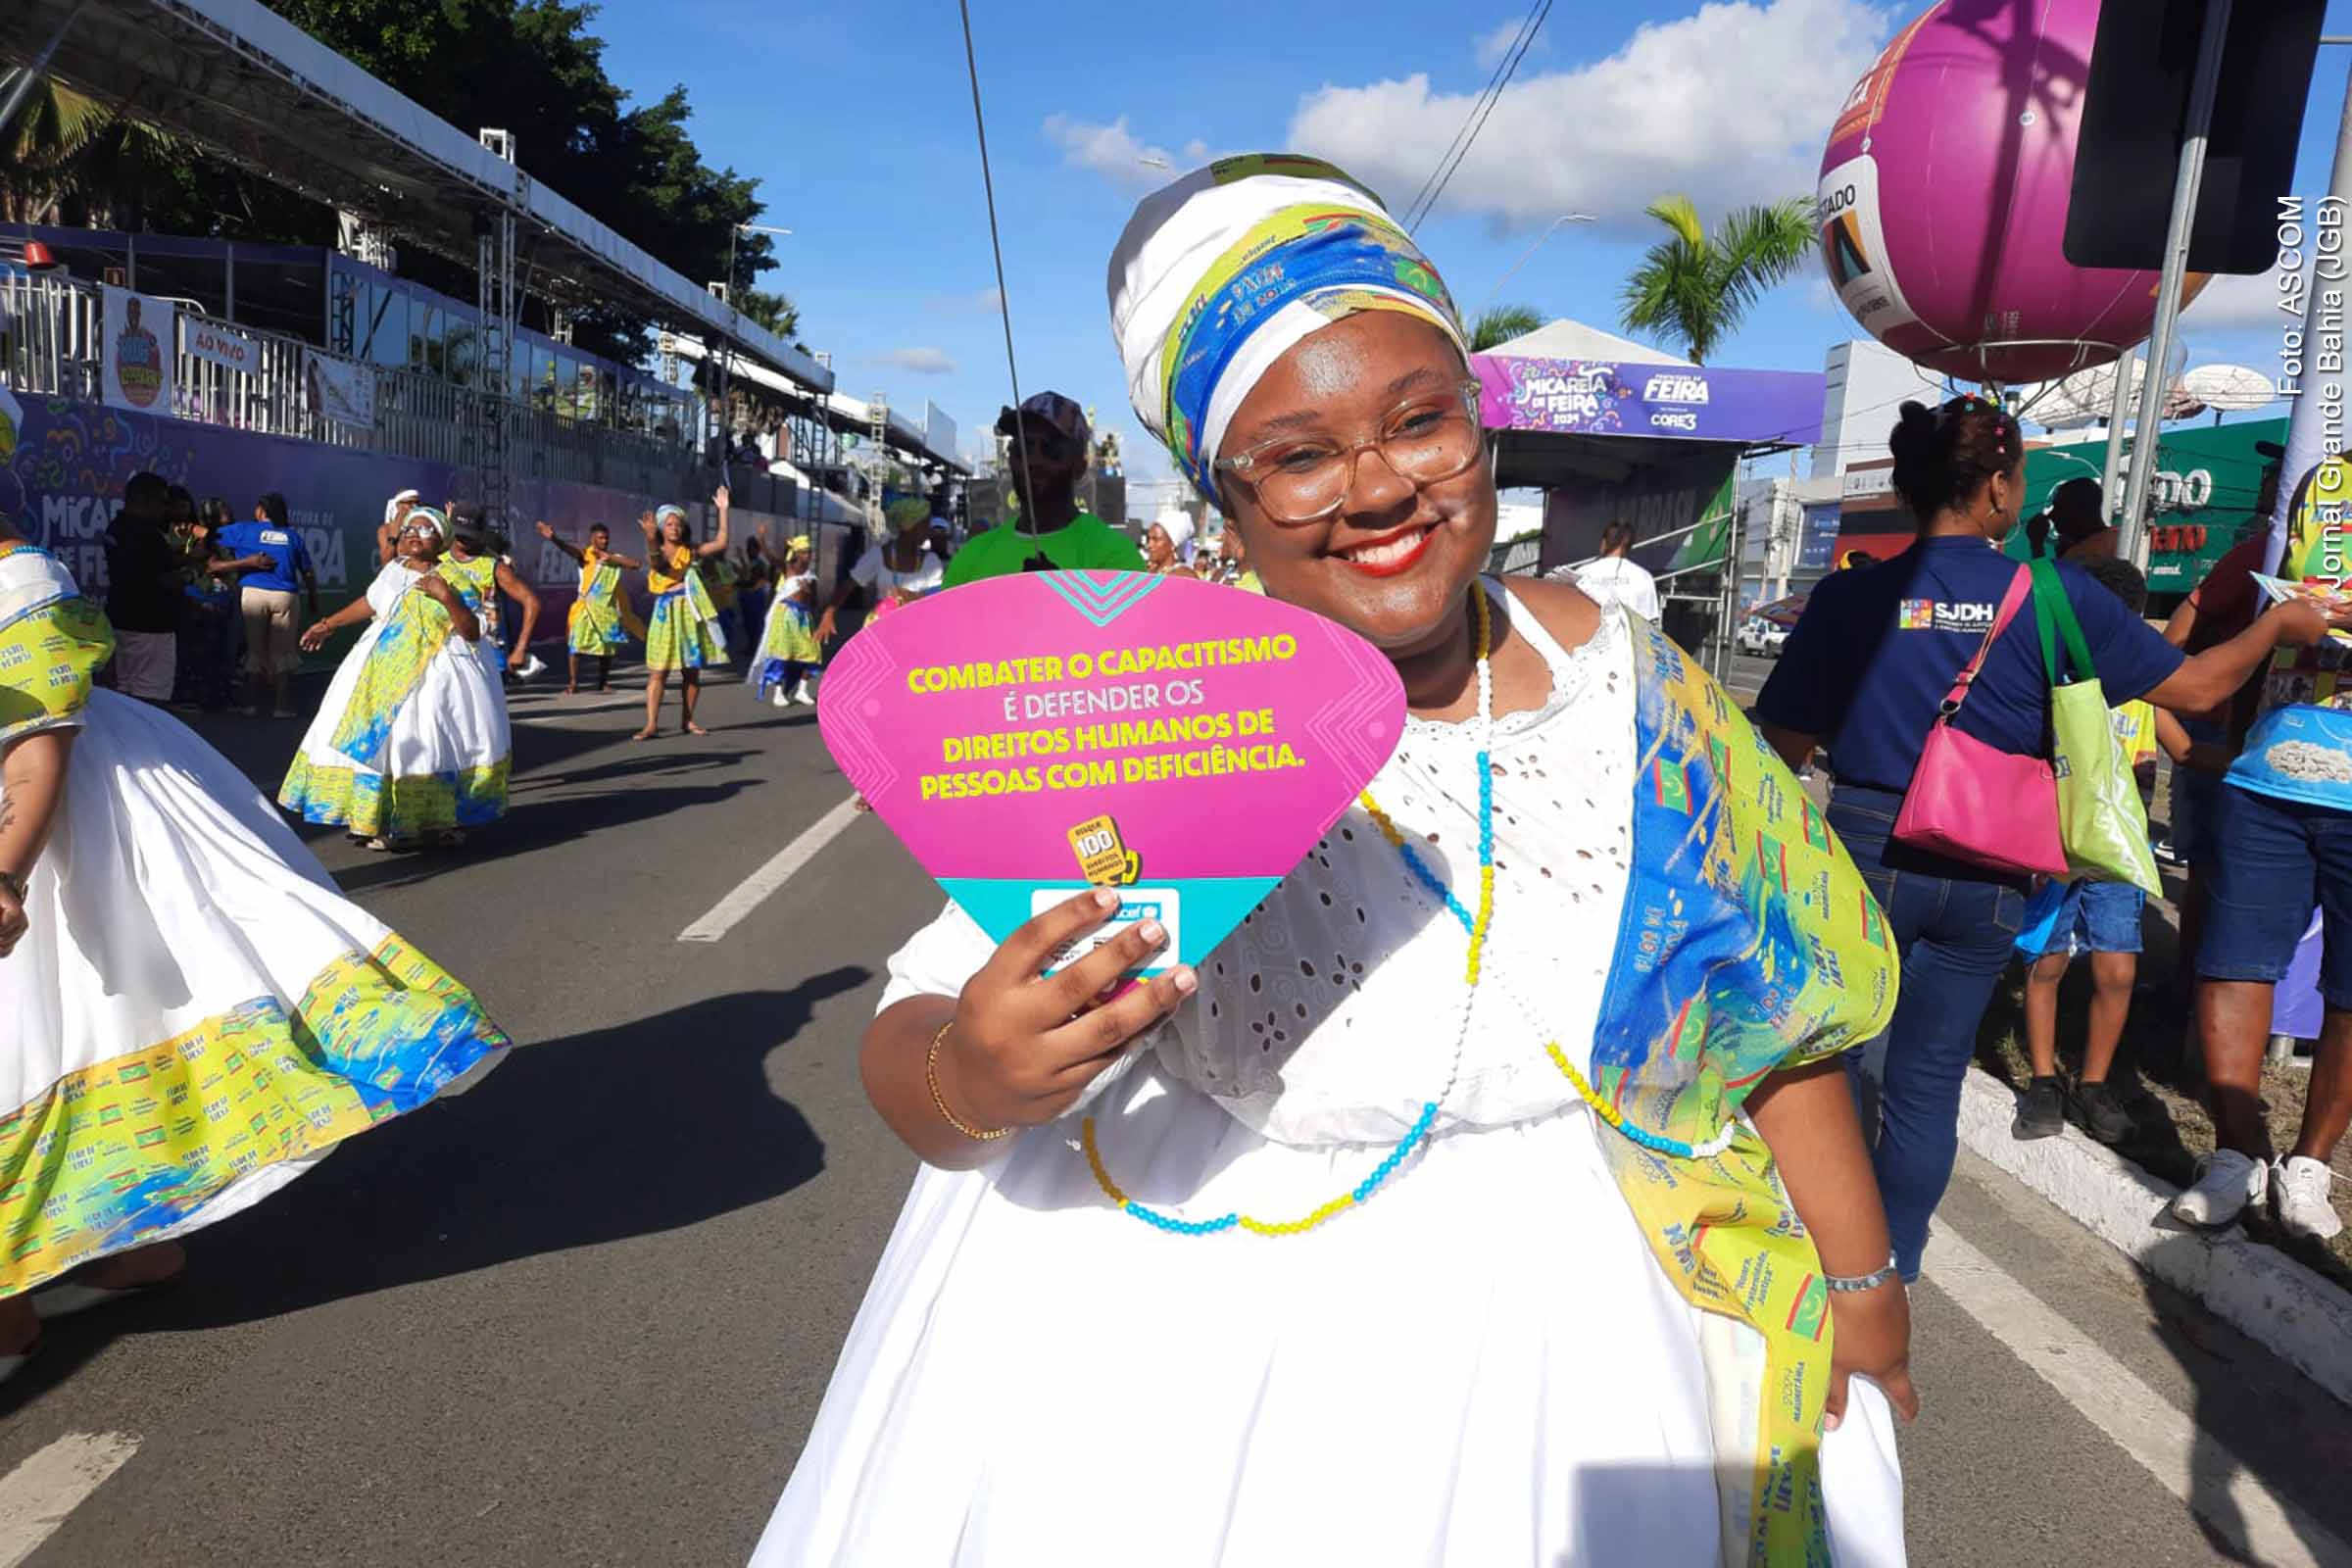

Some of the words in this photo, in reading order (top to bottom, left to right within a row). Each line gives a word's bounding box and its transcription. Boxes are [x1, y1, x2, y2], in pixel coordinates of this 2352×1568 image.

[196, 330, 214, 351] AO
[217, 338, 244, 362] VIVO
[1547, 393, 1599, 416] FEIRA
[1643, 379, 1709, 401] FEIRA
[1650, 414, 1697, 430] CORE3
[1935, 602, 1994, 621] SJDH
[907, 655, 1063, 695] COMBATER
[1067, 653, 1095, 680] O
[1097, 633, 1298, 677] CAPACITISMO
[1003, 690, 1019, 722] É
[1024, 684, 1160, 720] DEFENDER
[1164, 678, 1205, 707] OS
[942, 726, 1072, 763] DIREITOS
[1074, 711, 1234, 753] HUMANOS
[1237, 708, 1275, 737] DE
[919, 765, 1044, 801] PESSOAS
[1046, 760, 1118, 791] COM
[1121, 742, 1306, 784] DEFICIÊNCIA.
[1076, 830, 1113, 858] 100
